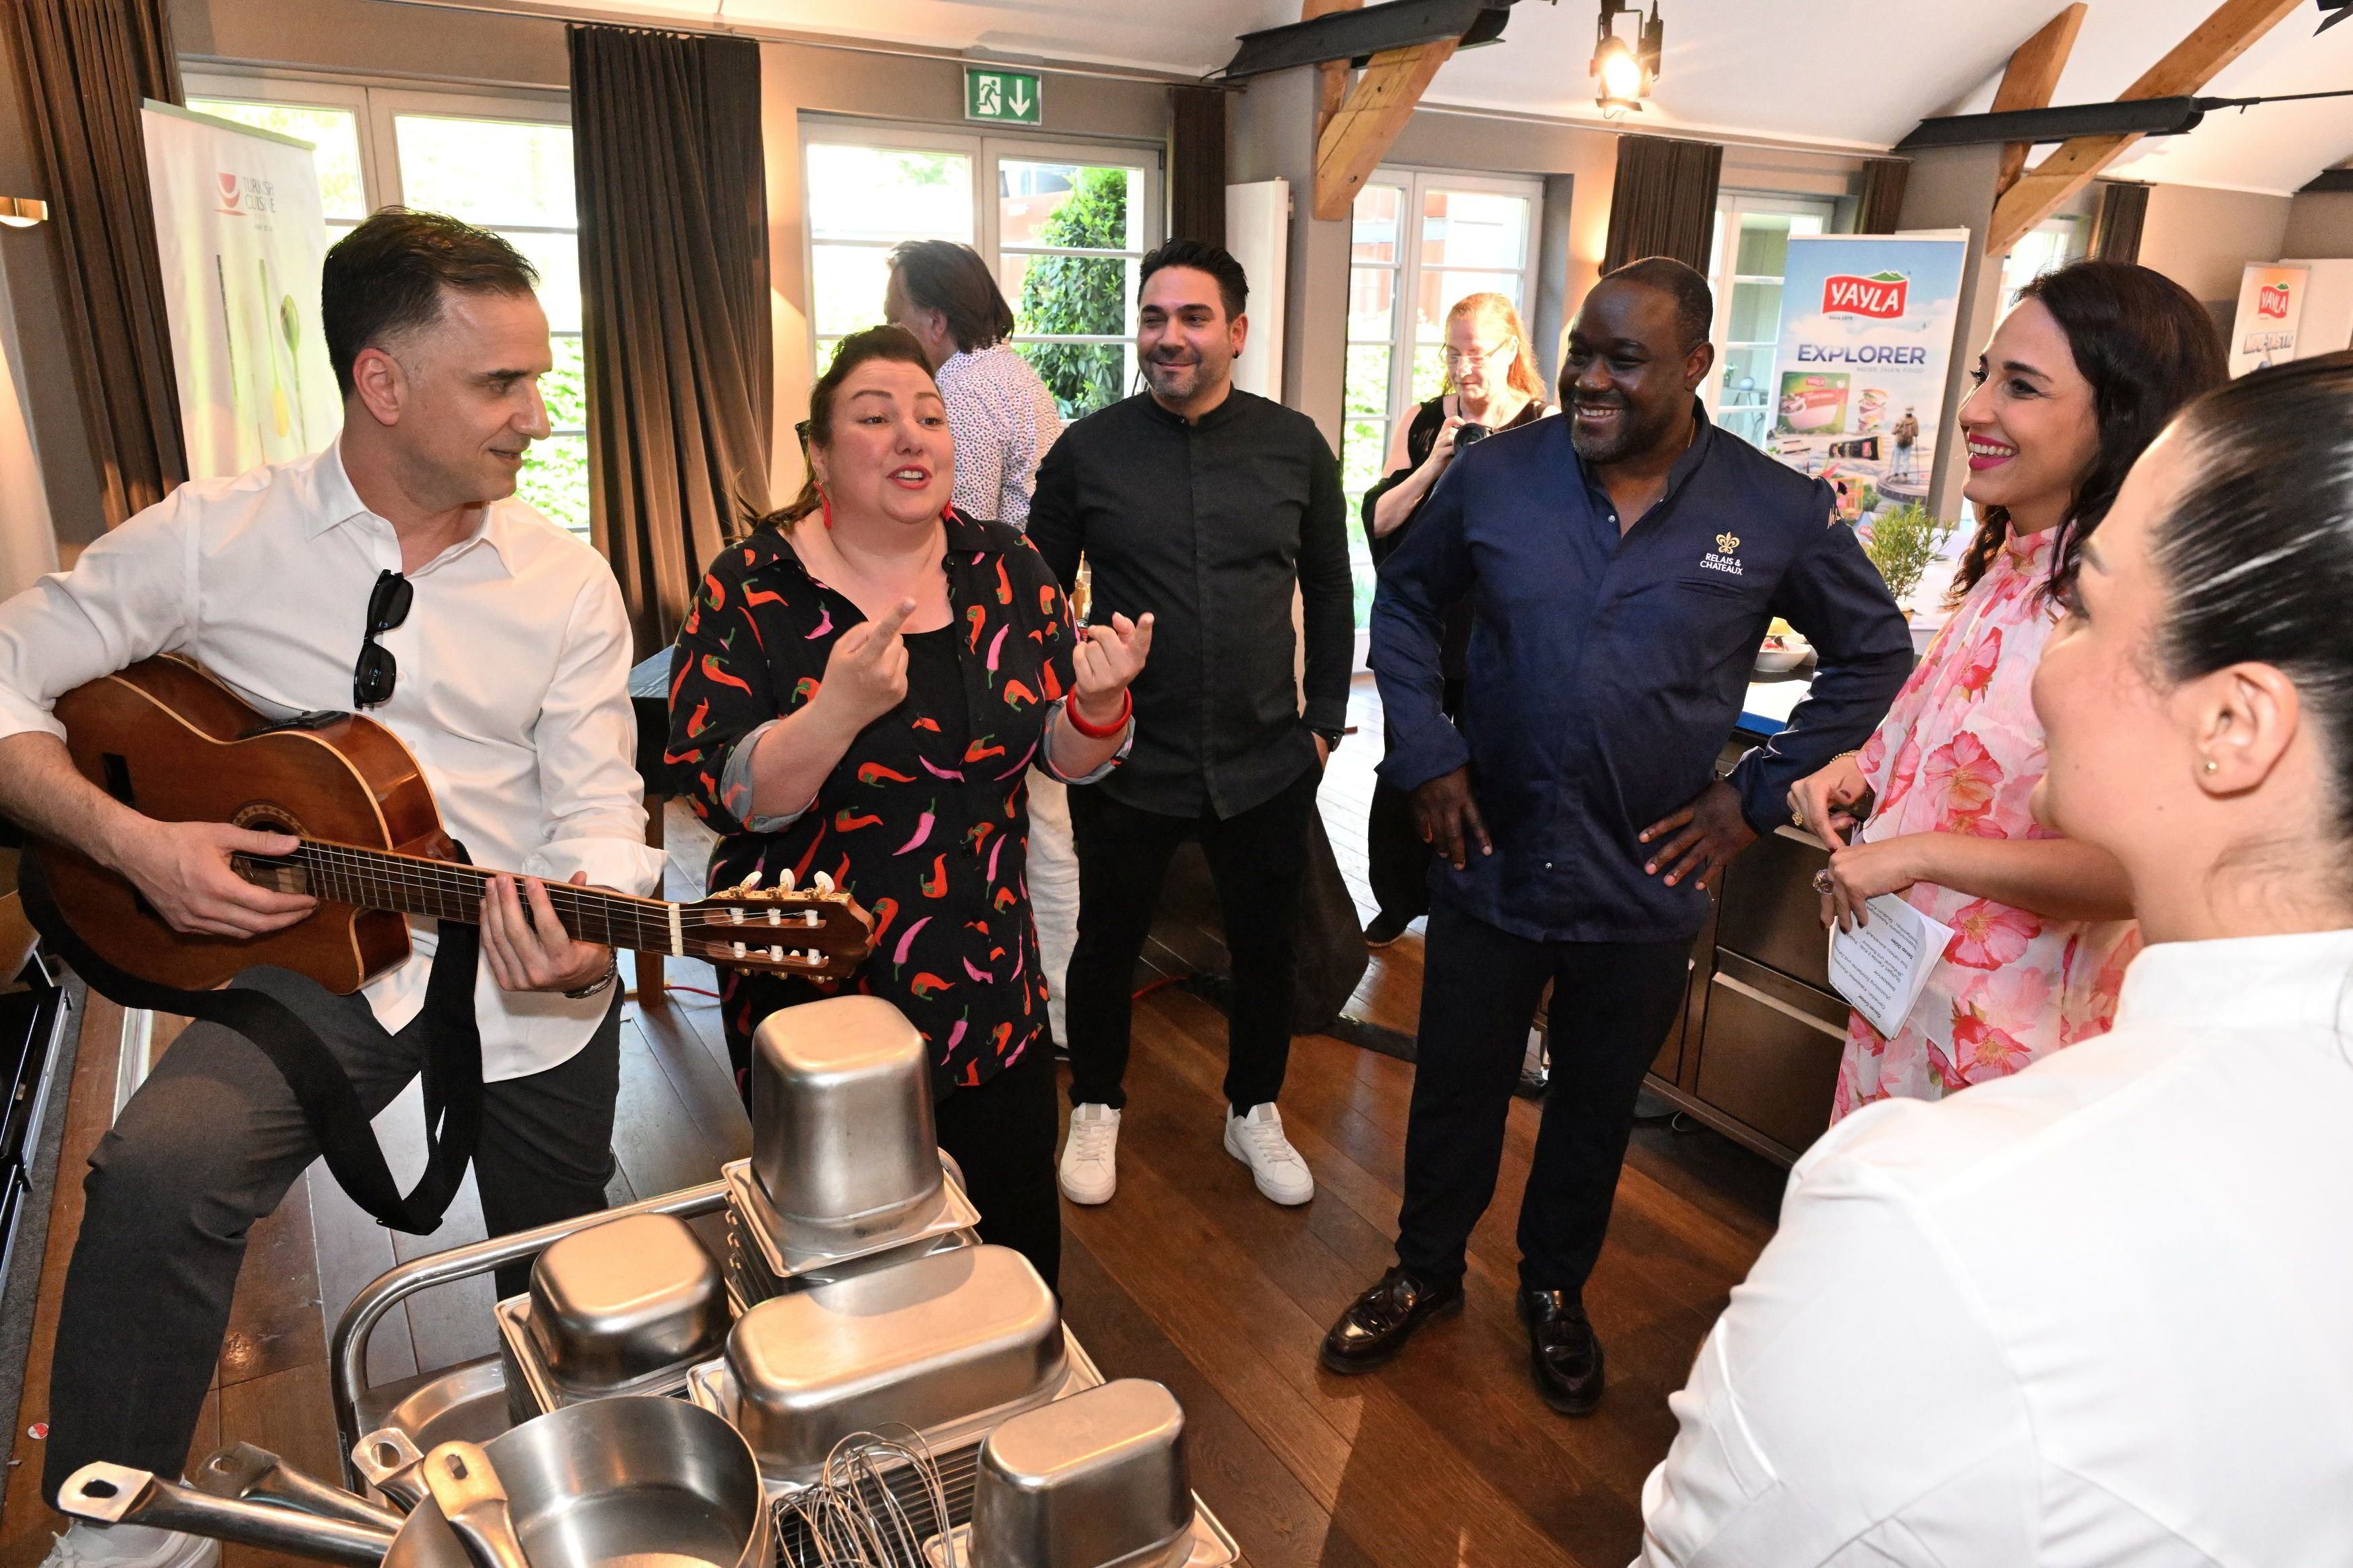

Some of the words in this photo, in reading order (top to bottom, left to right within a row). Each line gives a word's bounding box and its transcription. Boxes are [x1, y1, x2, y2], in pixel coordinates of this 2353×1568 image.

[1831, 282, 1899, 312] YAYLA
[2261, 290, 2286, 314] YAYLA
[1798, 344, 1927, 364] EXPLORER
[1706, 552, 1733, 565] RELAIS
[1700, 561, 1743, 575] CHATEAUX
[1900, 946, 1914, 960] Serap
